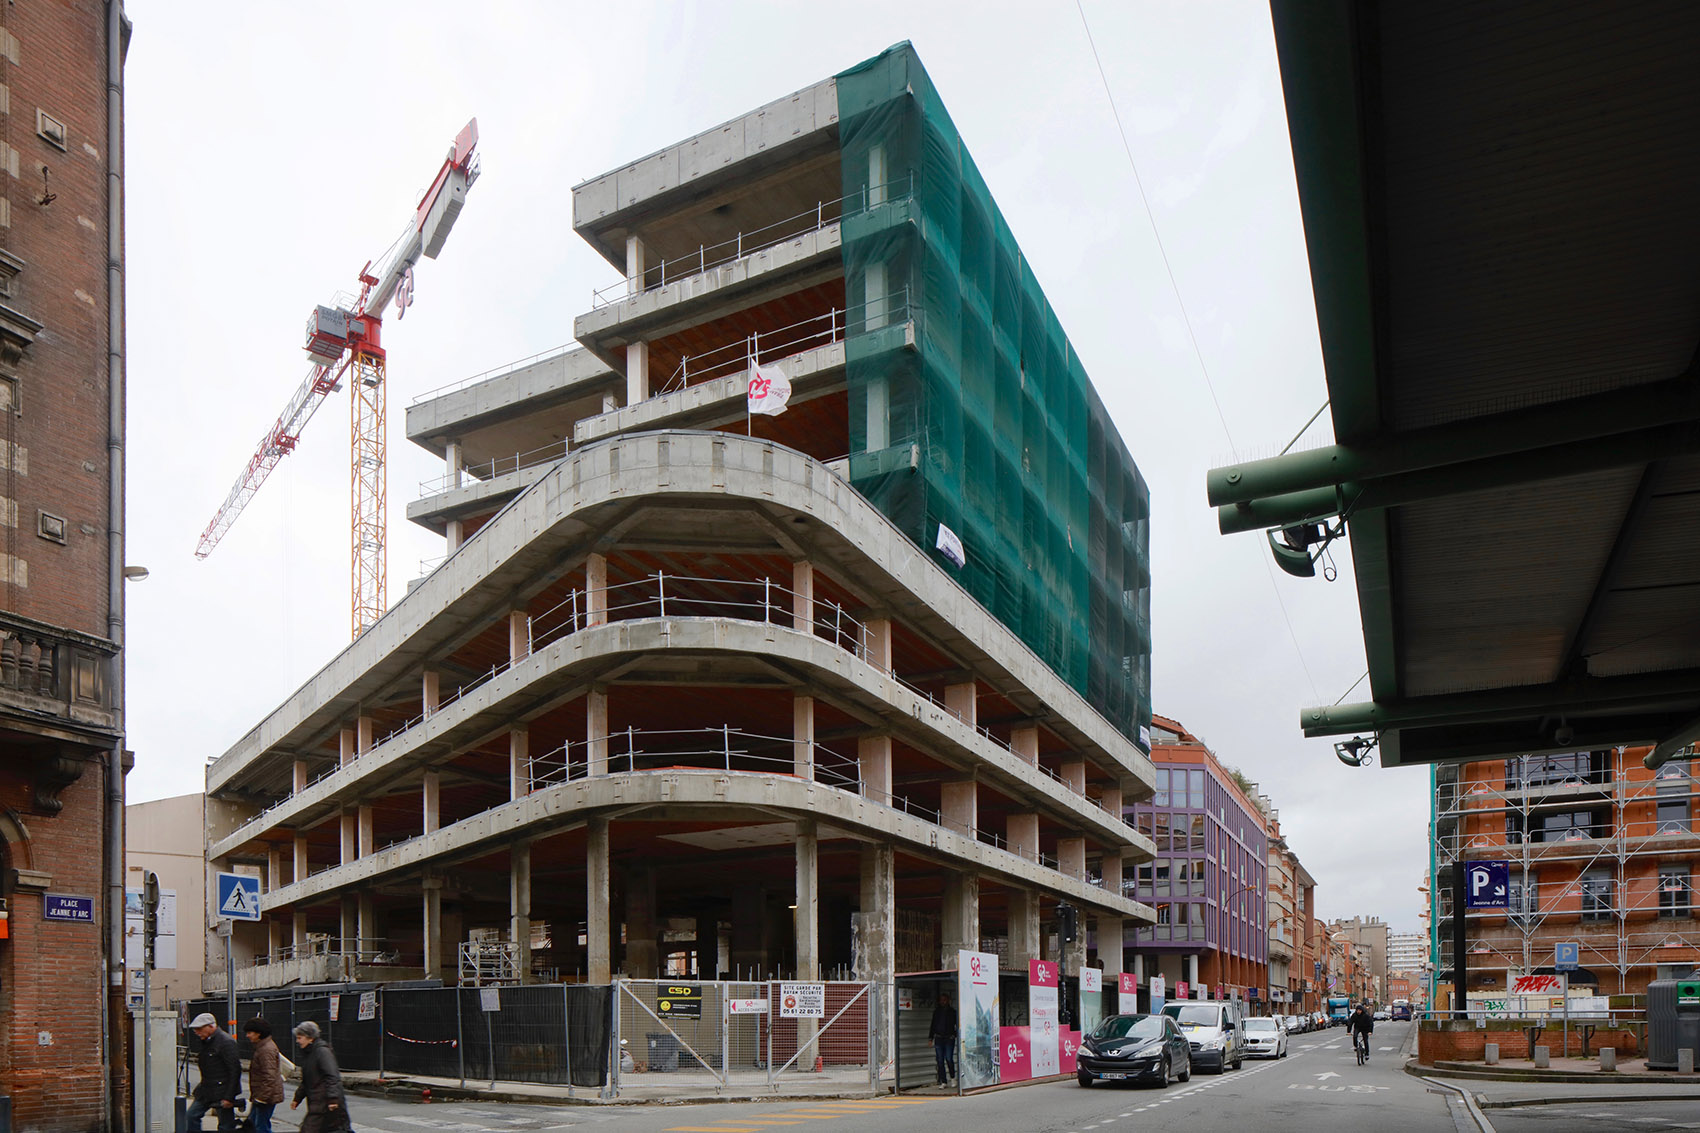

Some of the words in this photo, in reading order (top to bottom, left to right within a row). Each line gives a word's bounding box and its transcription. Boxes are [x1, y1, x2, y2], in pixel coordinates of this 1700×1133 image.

[1473, 871, 1490, 896] P
[60, 899, 78, 907] PLACE
[50, 908, 71, 917] JEANNE
[72, 910, 89, 918] D'ARC
[1562, 947, 1572, 959] P
